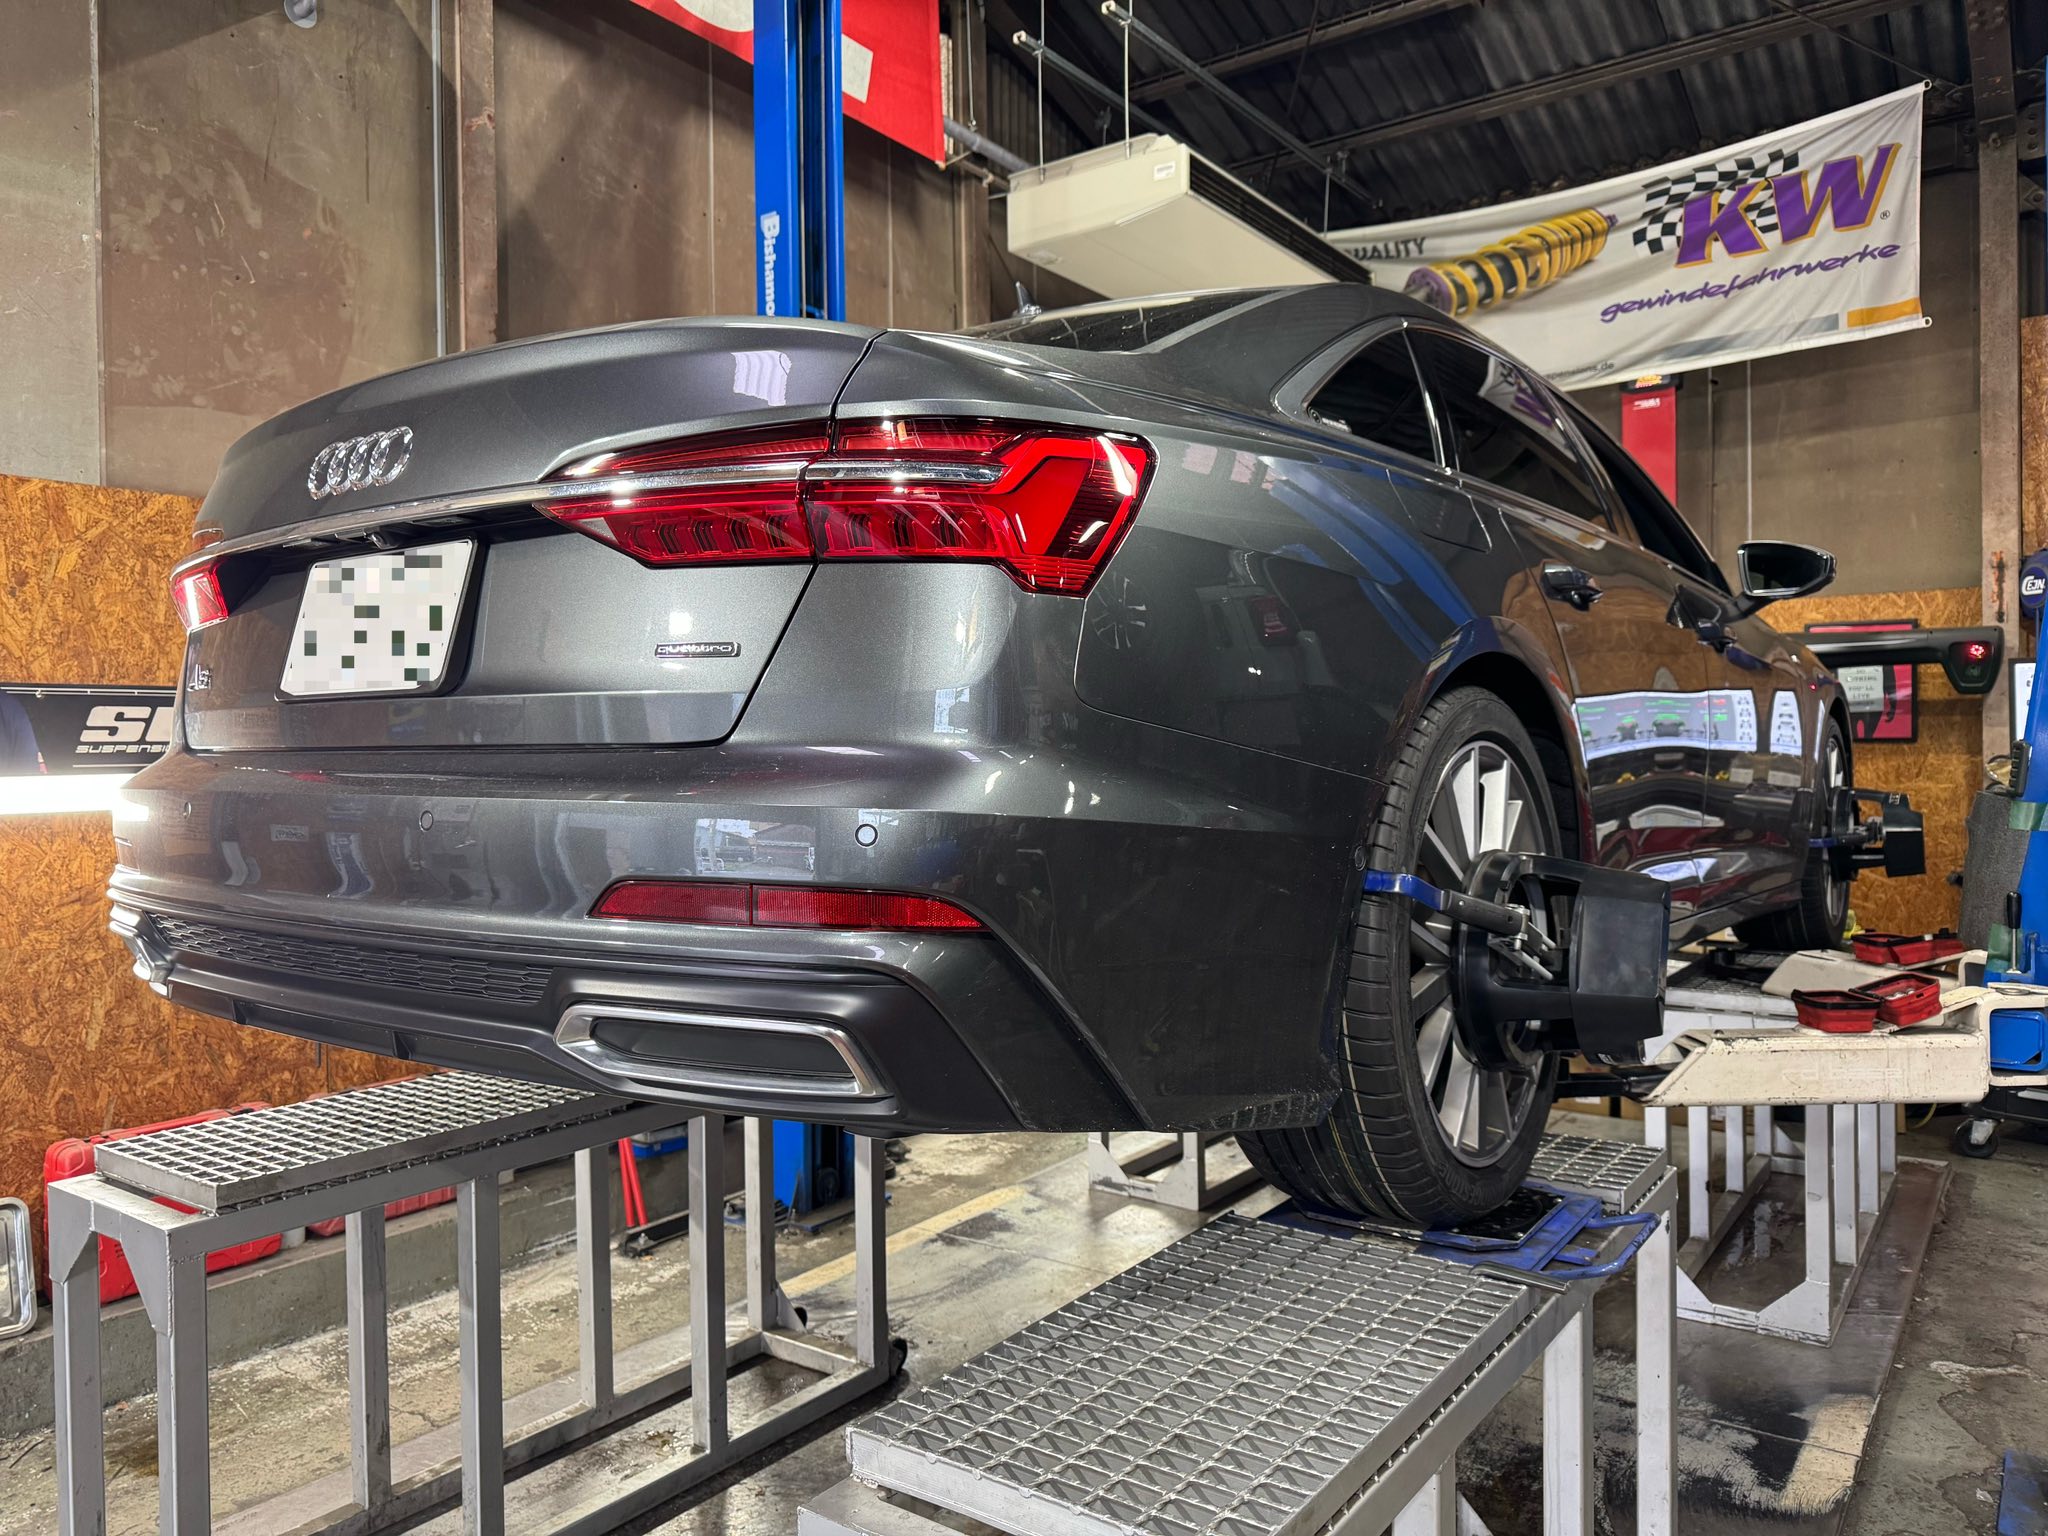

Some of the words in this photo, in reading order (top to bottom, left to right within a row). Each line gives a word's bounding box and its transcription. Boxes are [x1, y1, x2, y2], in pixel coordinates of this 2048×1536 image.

[1674, 142, 1902, 269] KW
[760, 210, 780, 317] Bishamo
[1350, 236, 1426, 261] UALITY
[1600, 244, 1901, 323] gewindefahrwerke
[2021, 575, 2046, 596] CEJN
[657, 643, 733, 655] quattro
